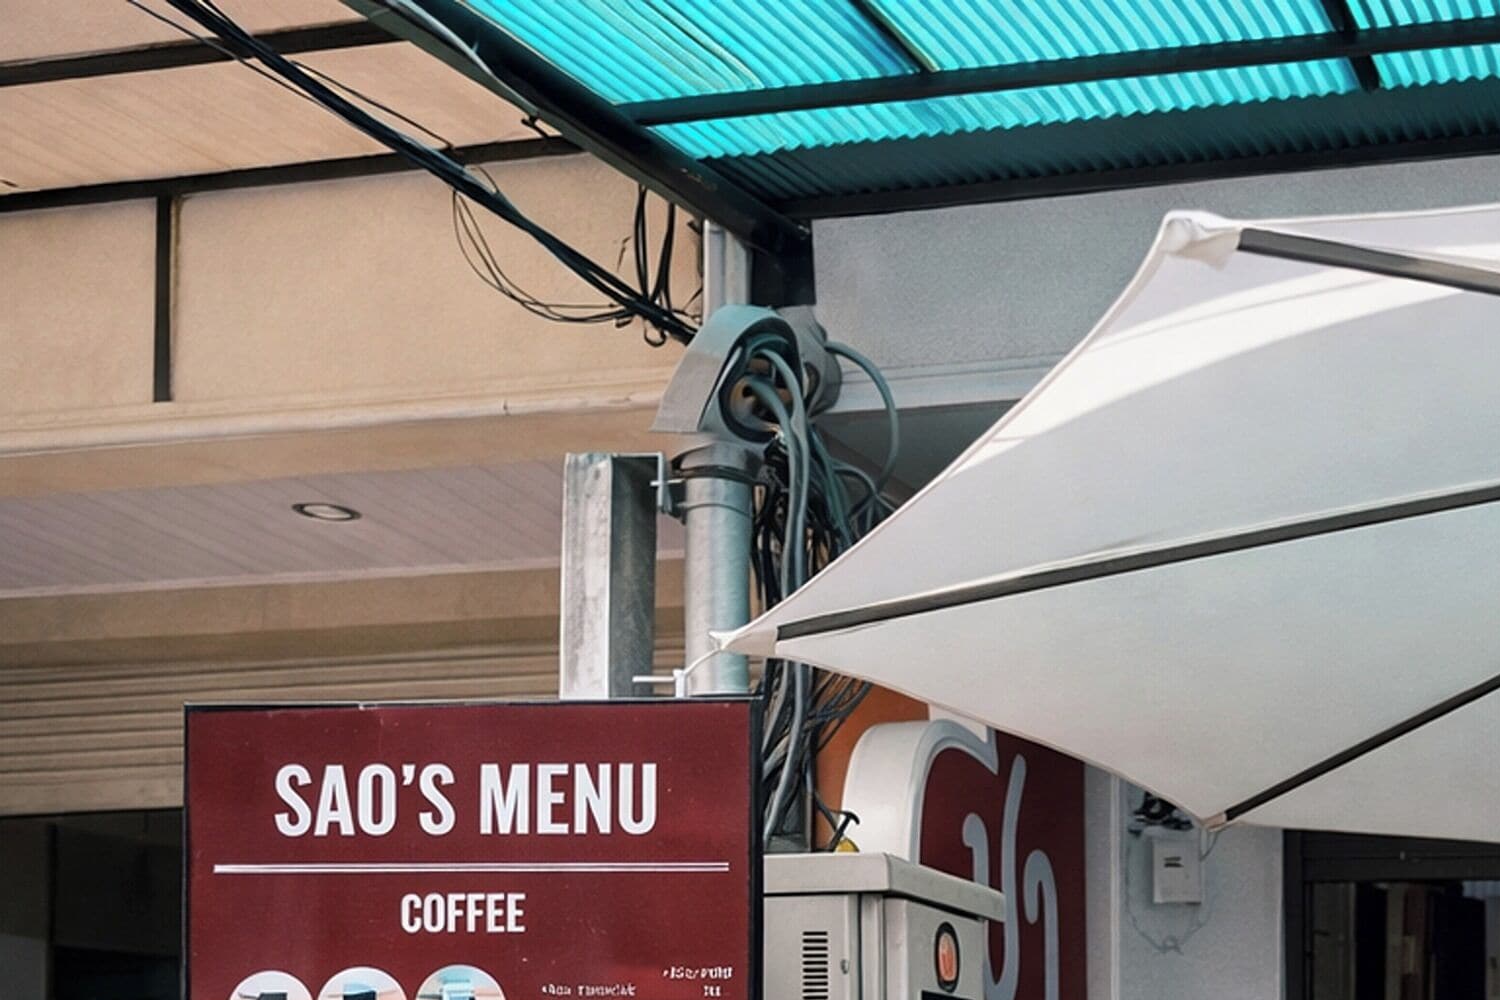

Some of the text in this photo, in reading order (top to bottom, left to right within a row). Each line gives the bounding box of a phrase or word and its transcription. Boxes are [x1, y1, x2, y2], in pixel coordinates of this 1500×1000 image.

[274, 763, 658, 837] SAO'S MENU
[401, 892, 526, 933] COFFEE
